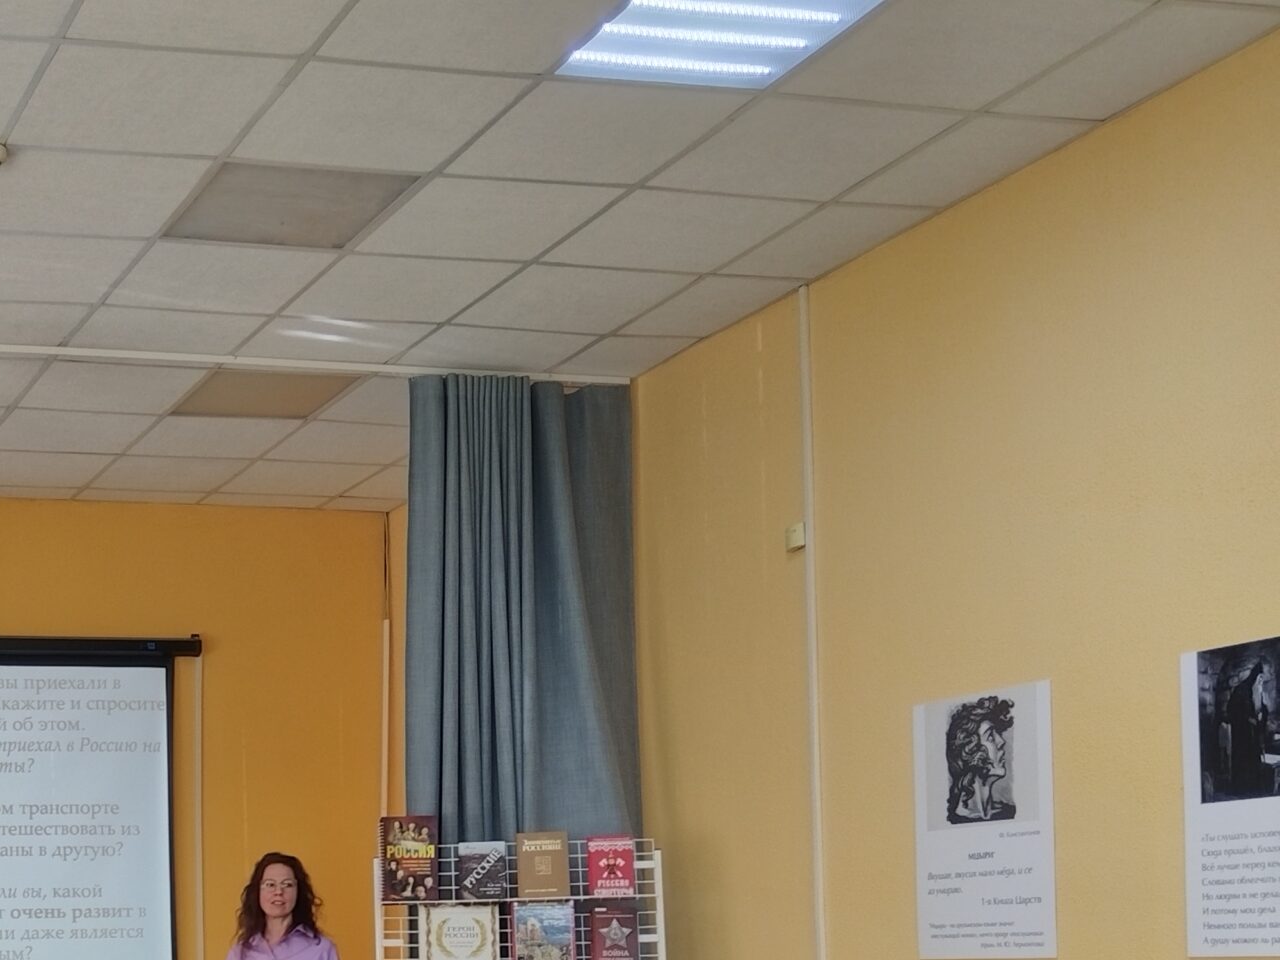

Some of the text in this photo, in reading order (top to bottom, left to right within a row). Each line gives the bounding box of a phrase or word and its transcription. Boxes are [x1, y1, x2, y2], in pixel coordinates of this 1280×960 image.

[24, 678, 107, 695] приехали
[112, 679, 122, 690] в
[71, 699, 81, 710] и
[86, 699, 165, 715] спросите
[12, 716, 34, 731] об
[38, 720, 86, 731] этом.
[66, 740, 75, 752] в
[79, 737, 138, 752] Россию
[142, 740, 161, 752] на
[0, 758, 35, 774] ты?
[19, 803, 120, 820] транспорте
[121, 824, 141, 836] из
[38, 846, 47, 857] в
[51, 841, 124, 861] другую?
[386, 845, 435, 858] РОССИЯ
[464, 848, 503, 888] РУССКИЕ
[22, 887, 48, 901] вы,
[53, 883, 103, 898] какой
[10, 907, 66, 919] очень
[71, 907, 134, 923] развит
[139, 908, 147, 918] в
[20, 928, 65, 942] даже
[69, 927, 145, 940] является
[602, 948, 629, 957] ВОЙНА
